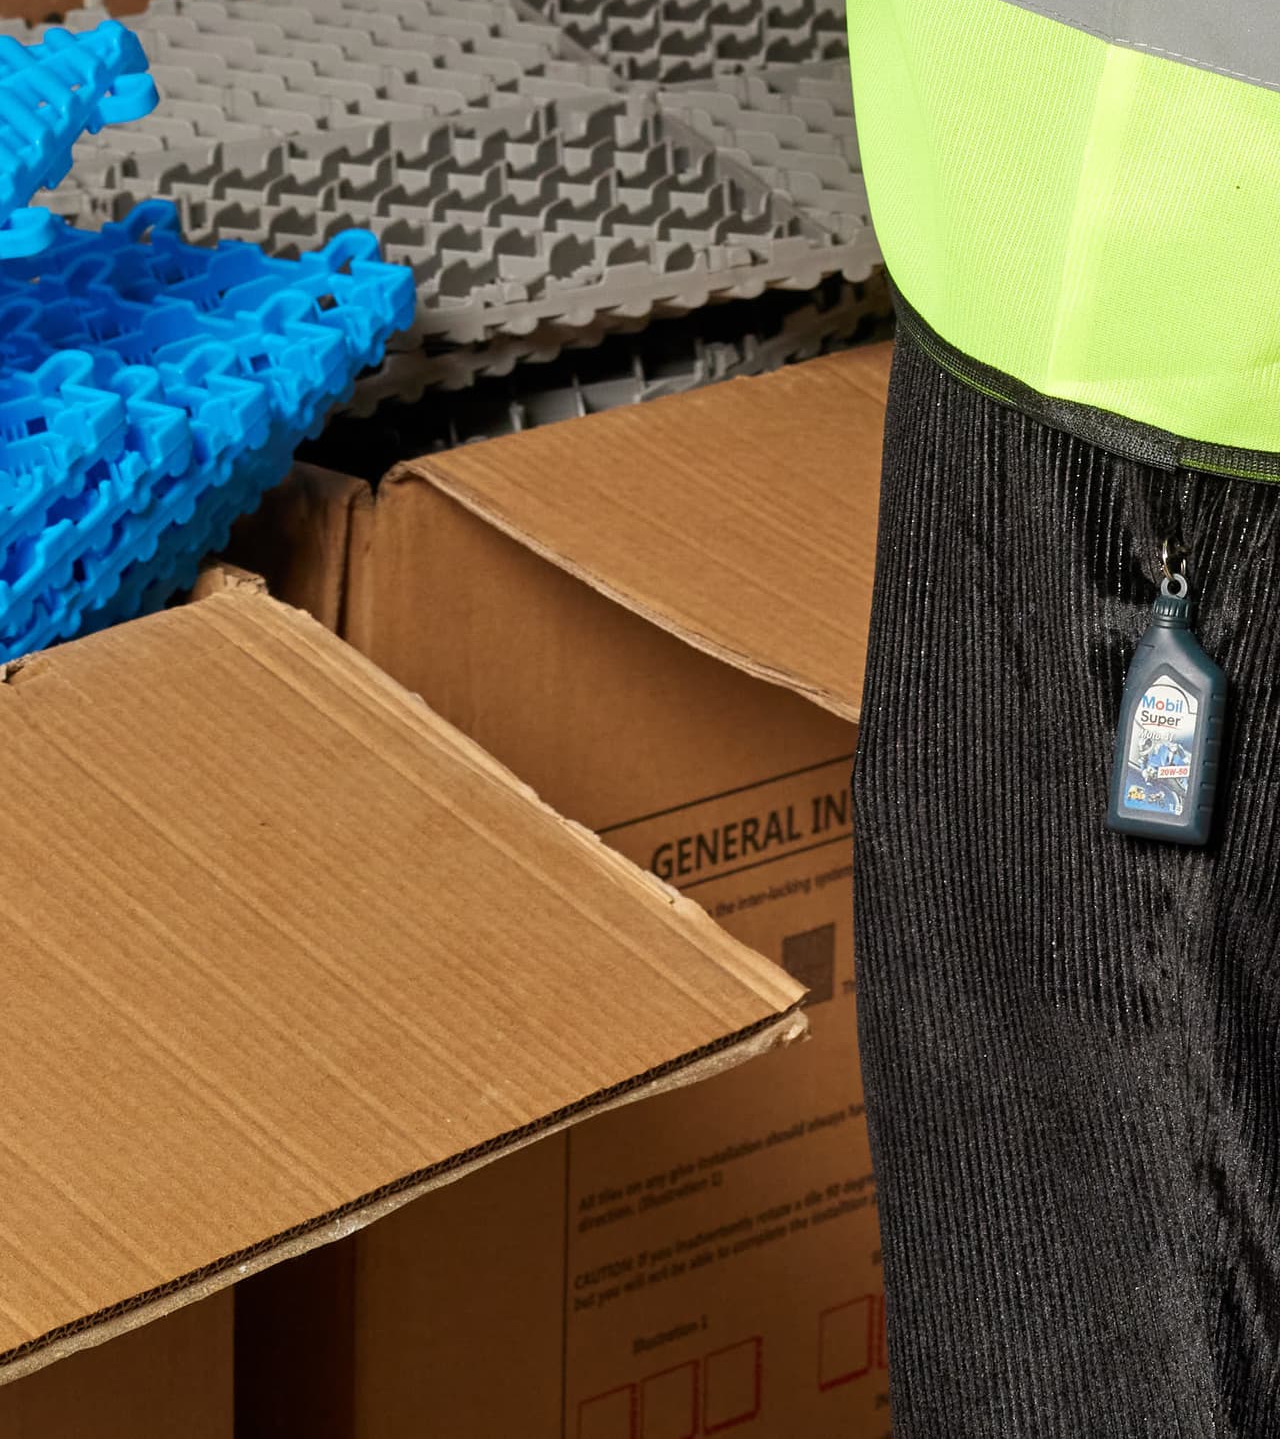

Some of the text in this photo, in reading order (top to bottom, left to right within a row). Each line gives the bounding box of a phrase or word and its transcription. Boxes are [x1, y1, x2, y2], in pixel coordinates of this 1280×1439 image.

[1142, 695, 1183, 713] Mobil
[1141, 710, 1180, 727] Super
[651, 806, 801, 881] GENERAL
